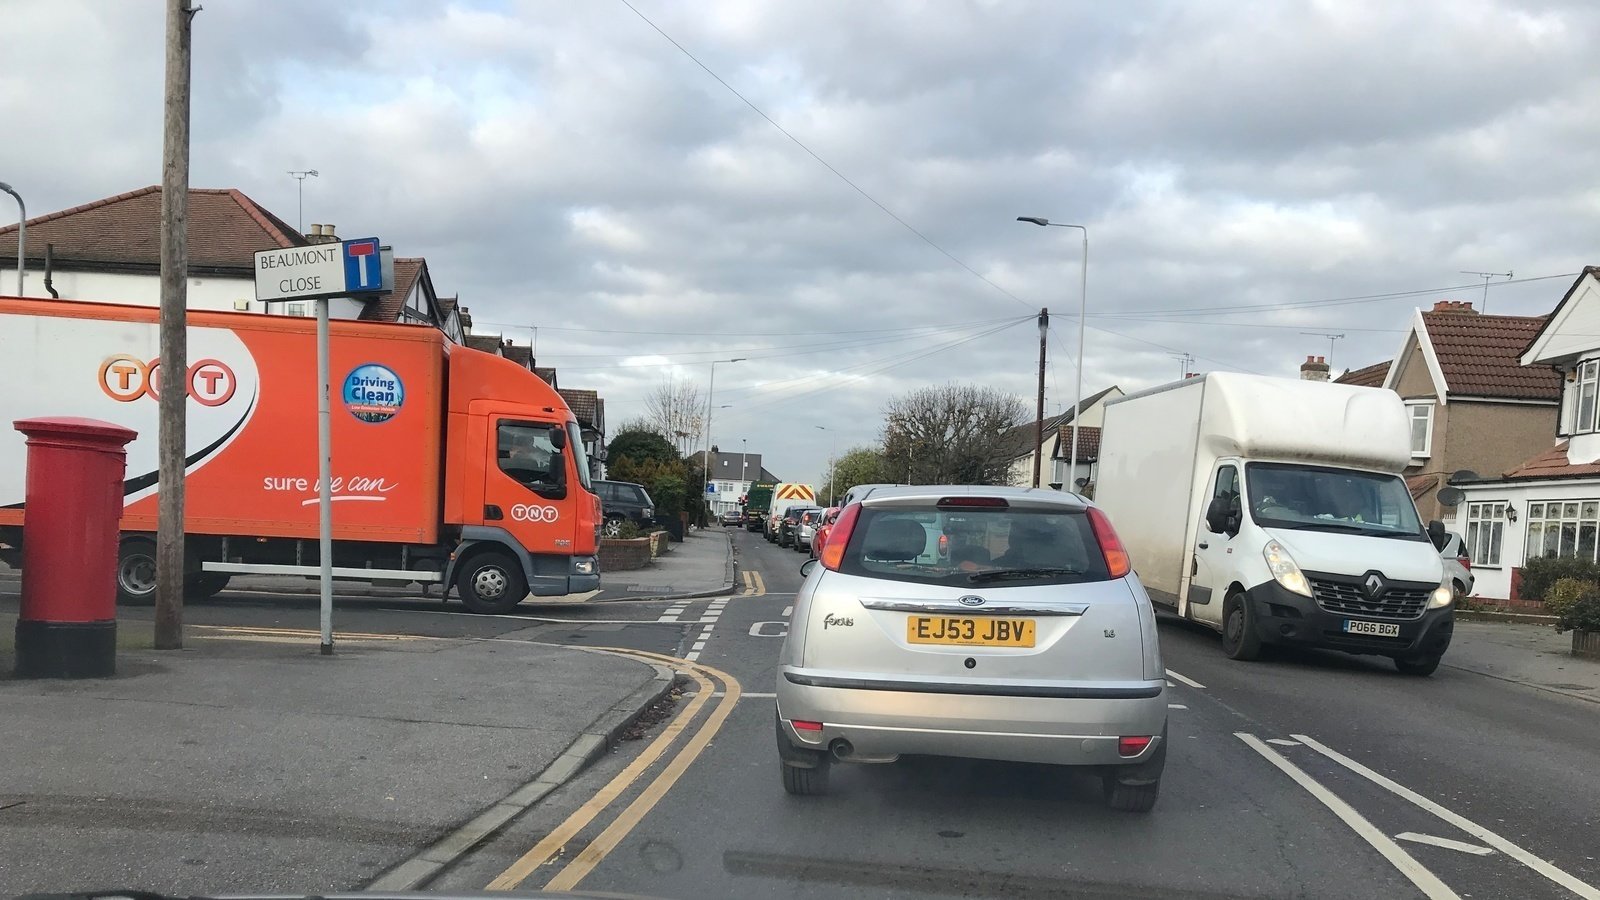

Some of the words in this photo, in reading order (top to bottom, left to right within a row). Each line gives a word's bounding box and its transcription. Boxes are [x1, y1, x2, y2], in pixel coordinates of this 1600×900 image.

[260, 248, 336, 270] BEAUMONT
[279, 276, 321, 293] CLOSE
[109, 363, 226, 397] TT
[351, 376, 395, 391] Driving
[351, 387, 395, 402] Clean
[263, 477, 308, 491] sure
[347, 476, 399, 492] can
[514, 506, 556, 520] TNT
[917, 618, 975, 640] EJ53
[982, 620, 1025, 642] JBV
[1378, 625, 1398, 635] BGX
